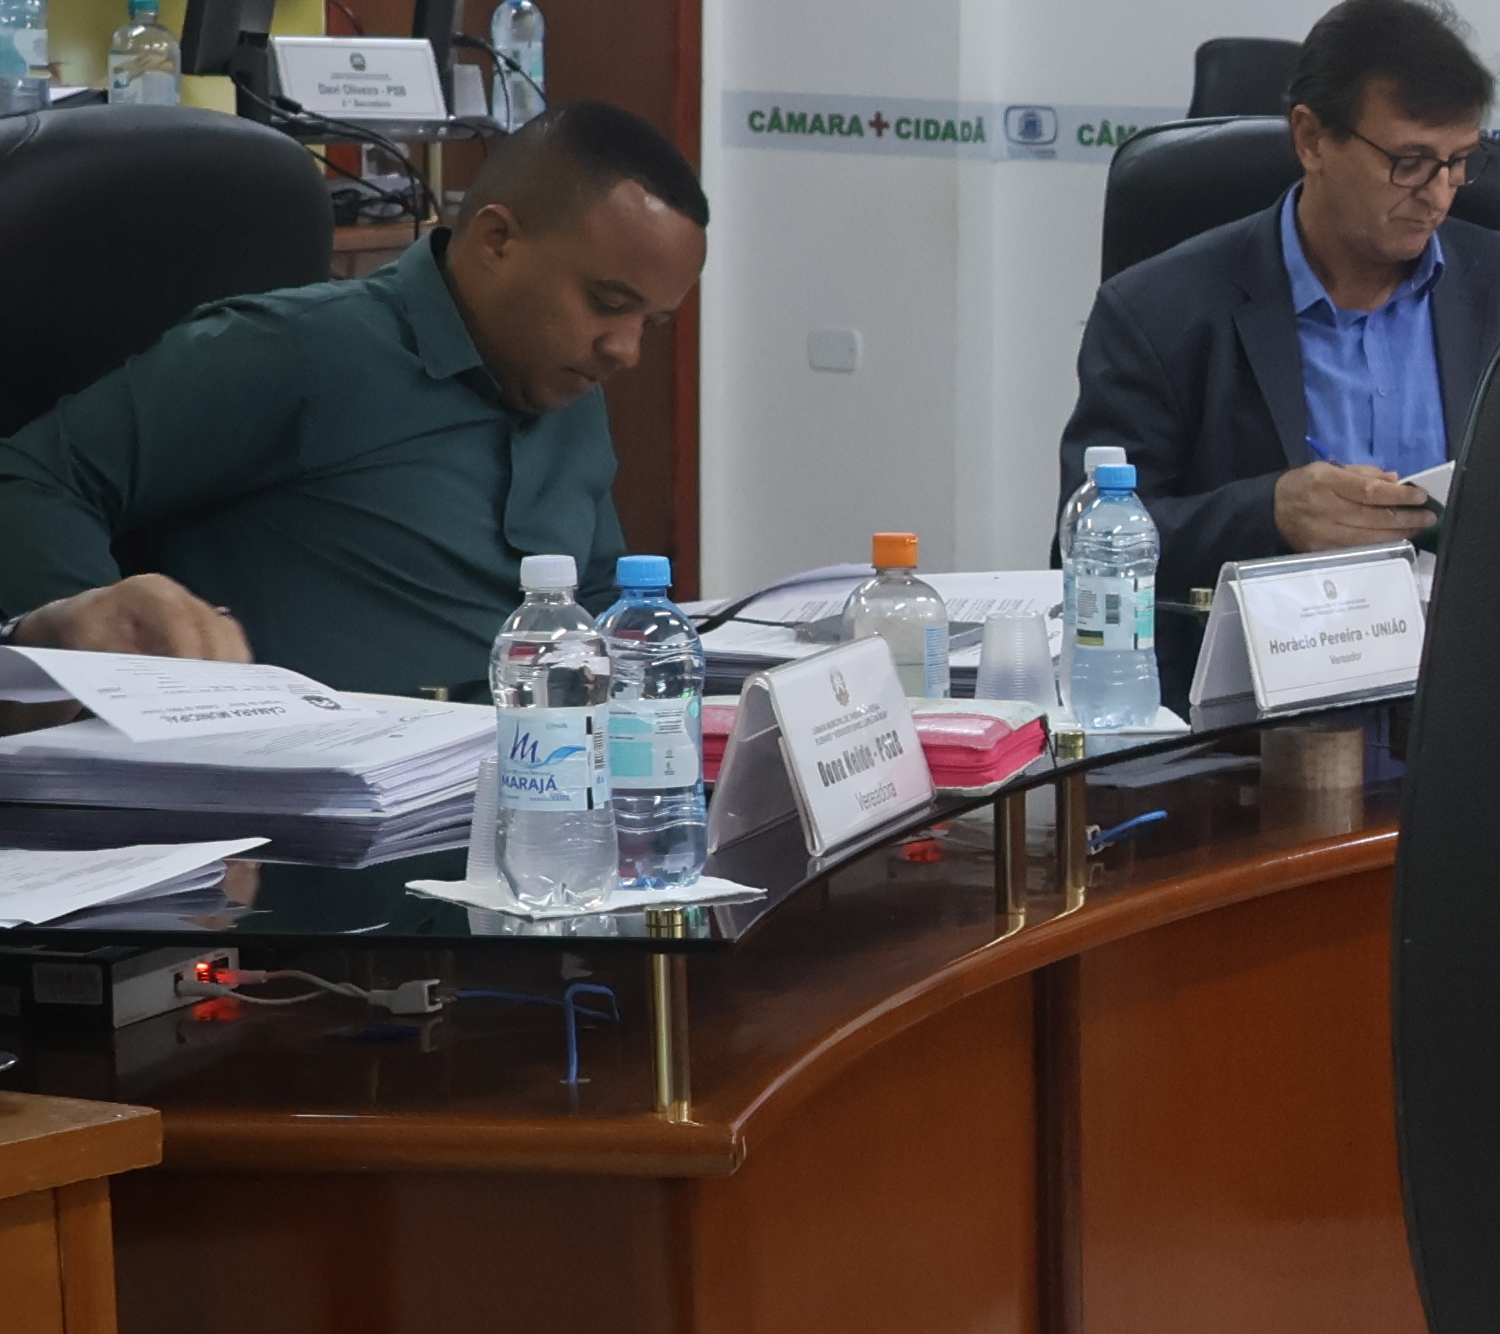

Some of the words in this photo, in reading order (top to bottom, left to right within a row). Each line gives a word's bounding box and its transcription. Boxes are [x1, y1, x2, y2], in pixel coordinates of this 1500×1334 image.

[1319, 628, 1363, 647] Pereira
[1371, 617, 1408, 638] UNIÃO
[501, 773, 558, 793] MARAJÁ
[854, 781, 898, 812] Vereadora
